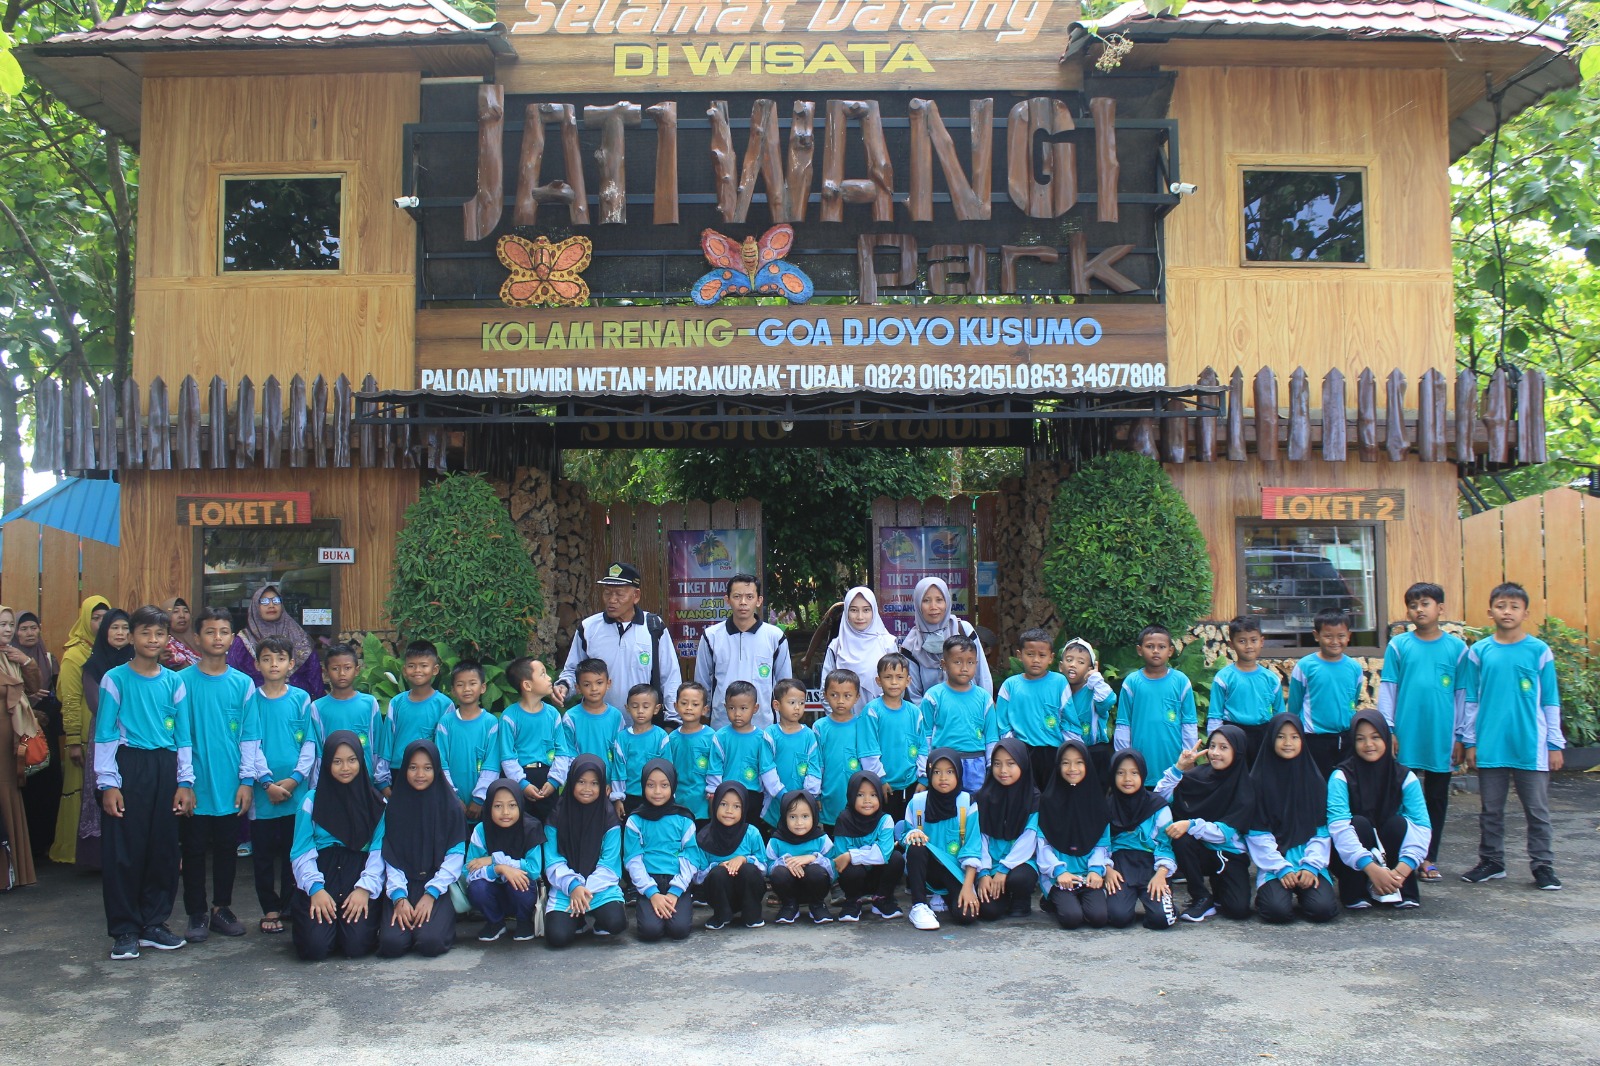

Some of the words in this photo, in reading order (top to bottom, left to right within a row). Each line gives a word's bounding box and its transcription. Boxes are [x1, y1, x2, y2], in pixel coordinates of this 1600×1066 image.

[510, 0, 800, 35] Selamat
[613, 43, 670, 77] DI
[681, 41, 936, 76] WISATA
[857, 232, 1142, 304] Park
[481, 321, 596, 351] KOLAM
[842, 317, 955, 347] DJOYO
[958, 317, 1103, 347] KUSUMO
[864, 363, 916, 389] 0823
[919, 363, 966, 389] 0163
[1071, 362, 1167, 388] 34677808
[188, 500, 295, 526] LOKET.1
[322, 550, 351, 561] BUKA
[677, 581, 707, 594] TIKET
[887, 573, 914, 586] TIKET
[700, 598, 725, 609] JATI
[675, 609, 717, 620] WANGI
[682, 623, 699, 639] Rp.
